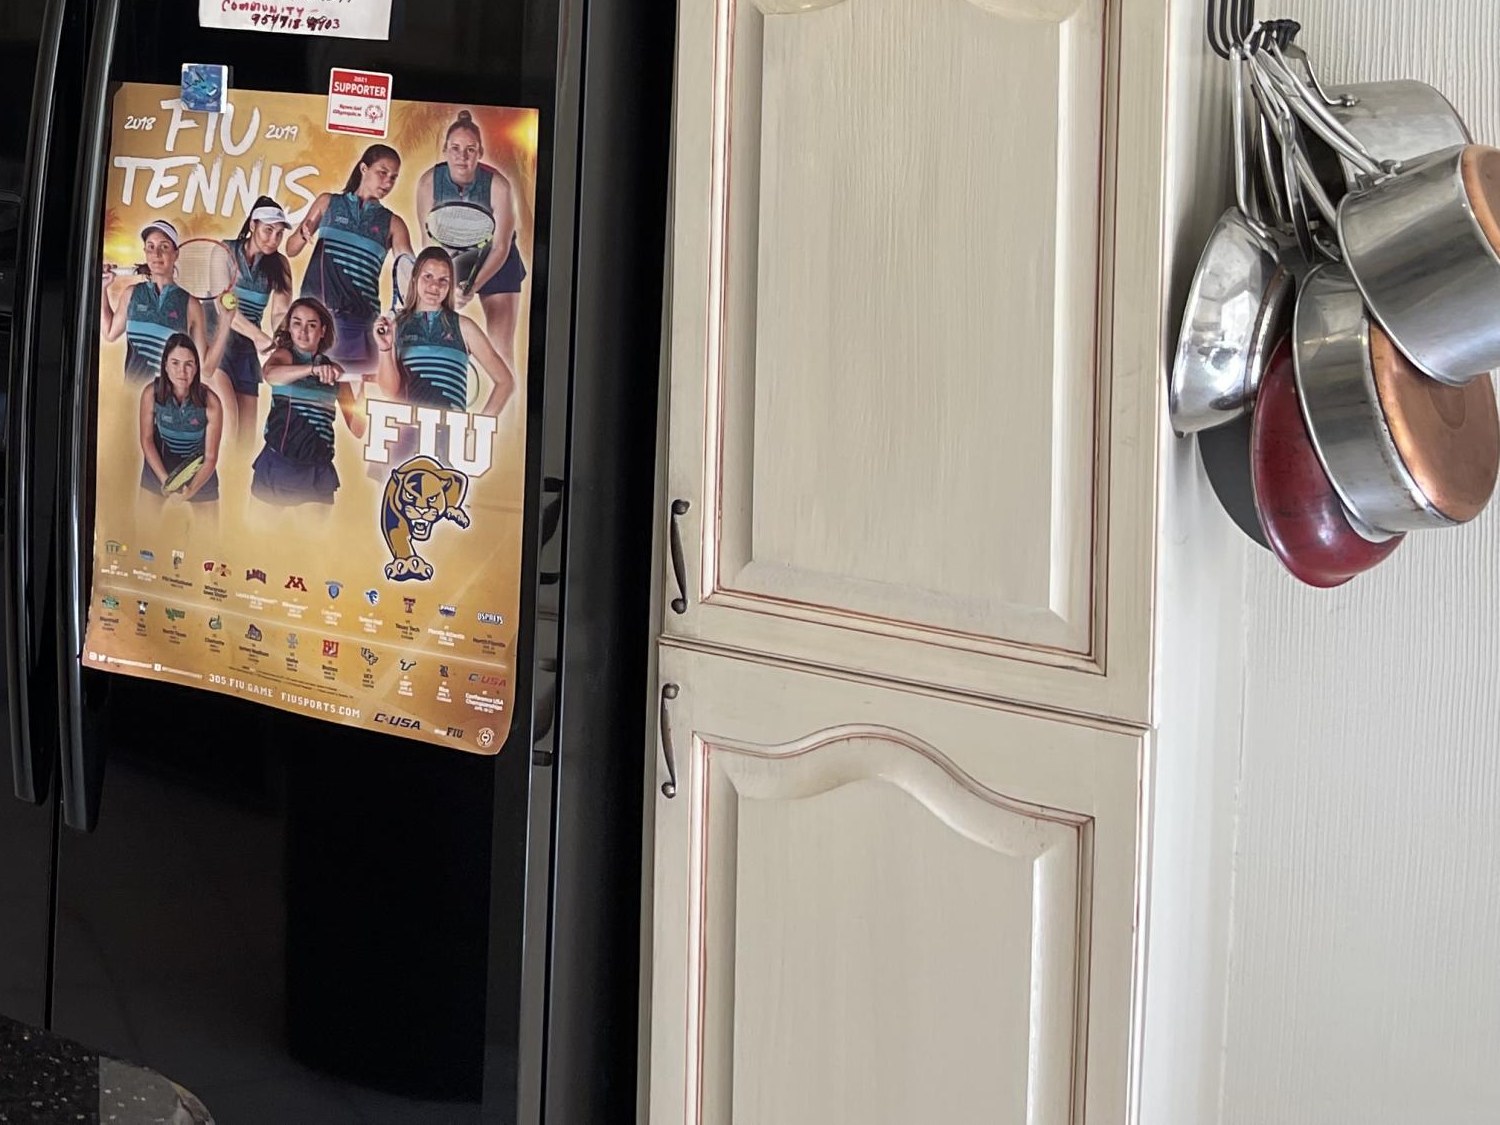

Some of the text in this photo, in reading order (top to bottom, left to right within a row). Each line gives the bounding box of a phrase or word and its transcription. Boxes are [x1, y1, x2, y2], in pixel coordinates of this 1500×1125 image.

[333, 81, 387, 98] SUPPORTER
[124, 115, 157, 131] 2018
[160, 98, 261, 156] FIU
[265, 124, 299, 142] 2019
[113, 154, 320, 224] TENNIS
[364, 398, 498, 478] FIU
